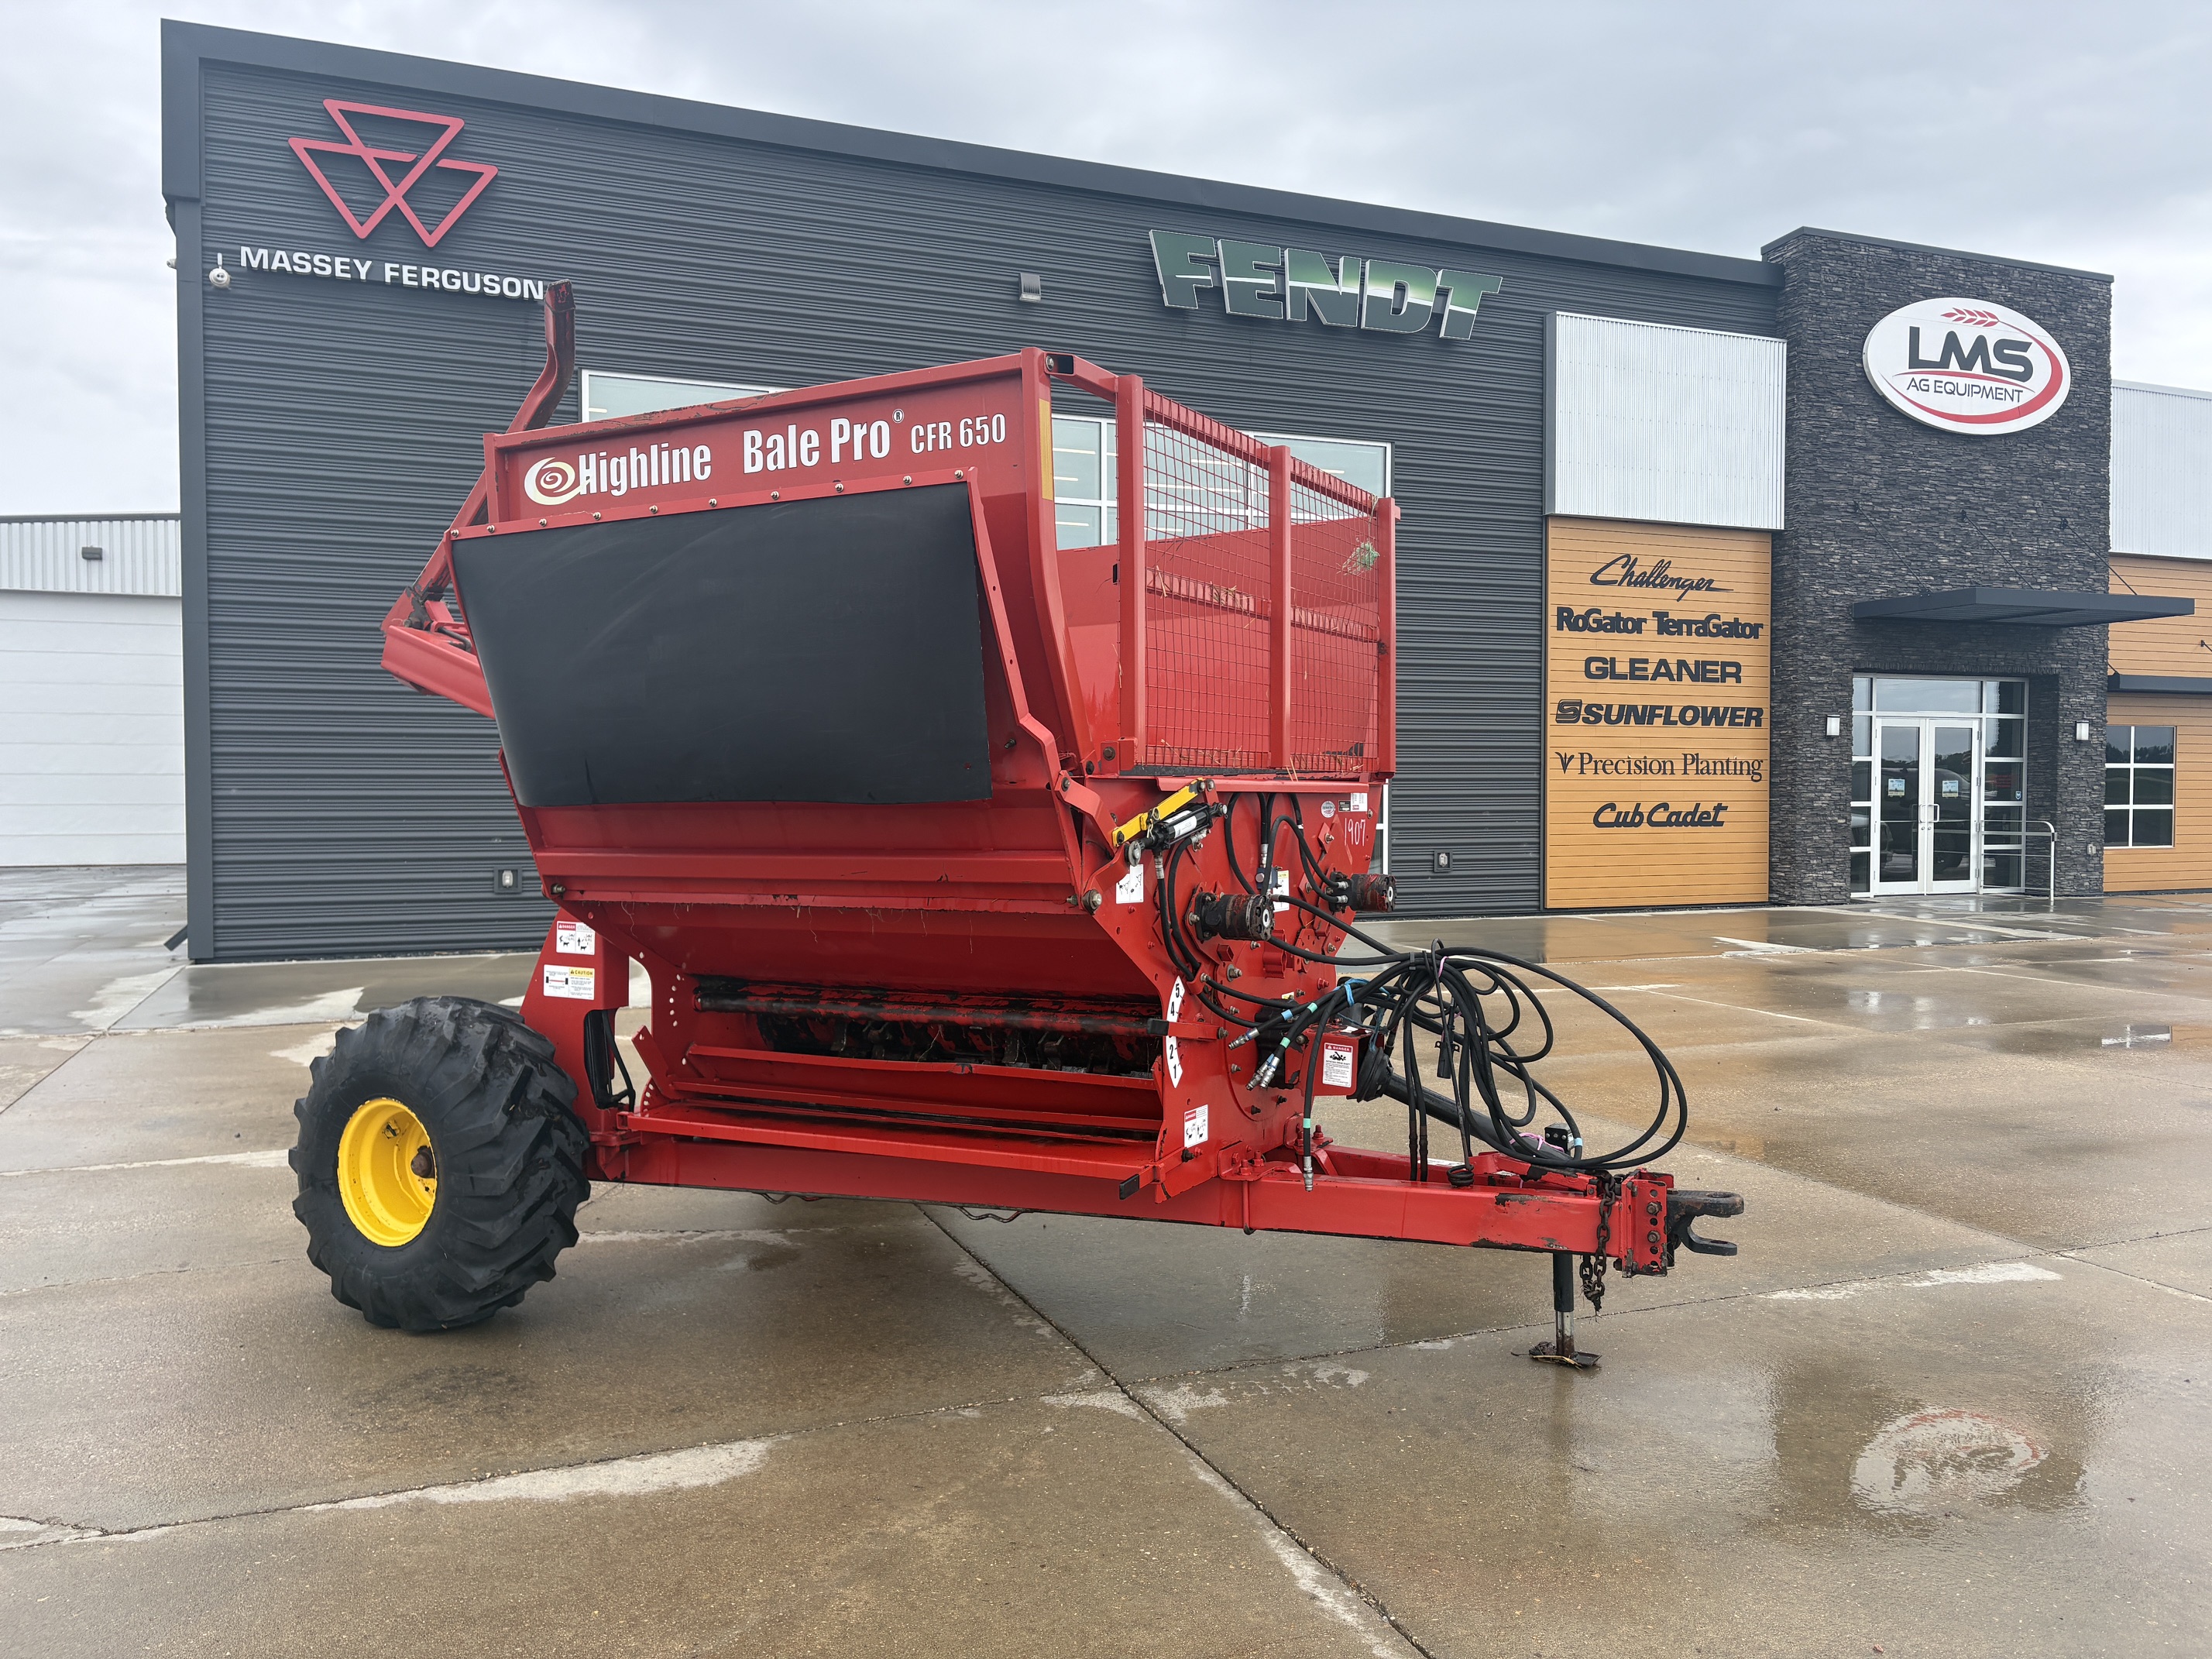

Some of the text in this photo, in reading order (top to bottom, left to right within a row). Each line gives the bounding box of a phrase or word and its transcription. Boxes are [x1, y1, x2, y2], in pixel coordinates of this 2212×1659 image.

[239, 246, 544, 301] MASSEY FERGUSON
[1148, 229, 1503, 340] FENDT
[1908, 325, 2034, 383] LMS
[1906, 377, 2024, 404] AG EQUIPMENT
[579, 442, 713, 497] Highline
[743, 424, 821, 475] Bale
[909, 421, 953, 455] CFR
[958, 412, 1007, 448] 650
[1589, 553, 1734, 603] Challenger
[1556, 606, 1764, 640] RoGator TerraGator
[1584, 656, 1743, 684] GLEANER
[1582, 703, 1764, 728] SUNFLOWER
[1578, 751, 1764, 783] Precision Planting
[1592, 802, 1729, 829] Cub Cadet
[1344, 817, 1366, 847] 1907
[1175, 983, 1180, 998] 5
[1170, 1001, 1175, 1016] 4
[1169, 1044, 1174, 1060] 2
[1173, 1063, 1176, 1079] 1
